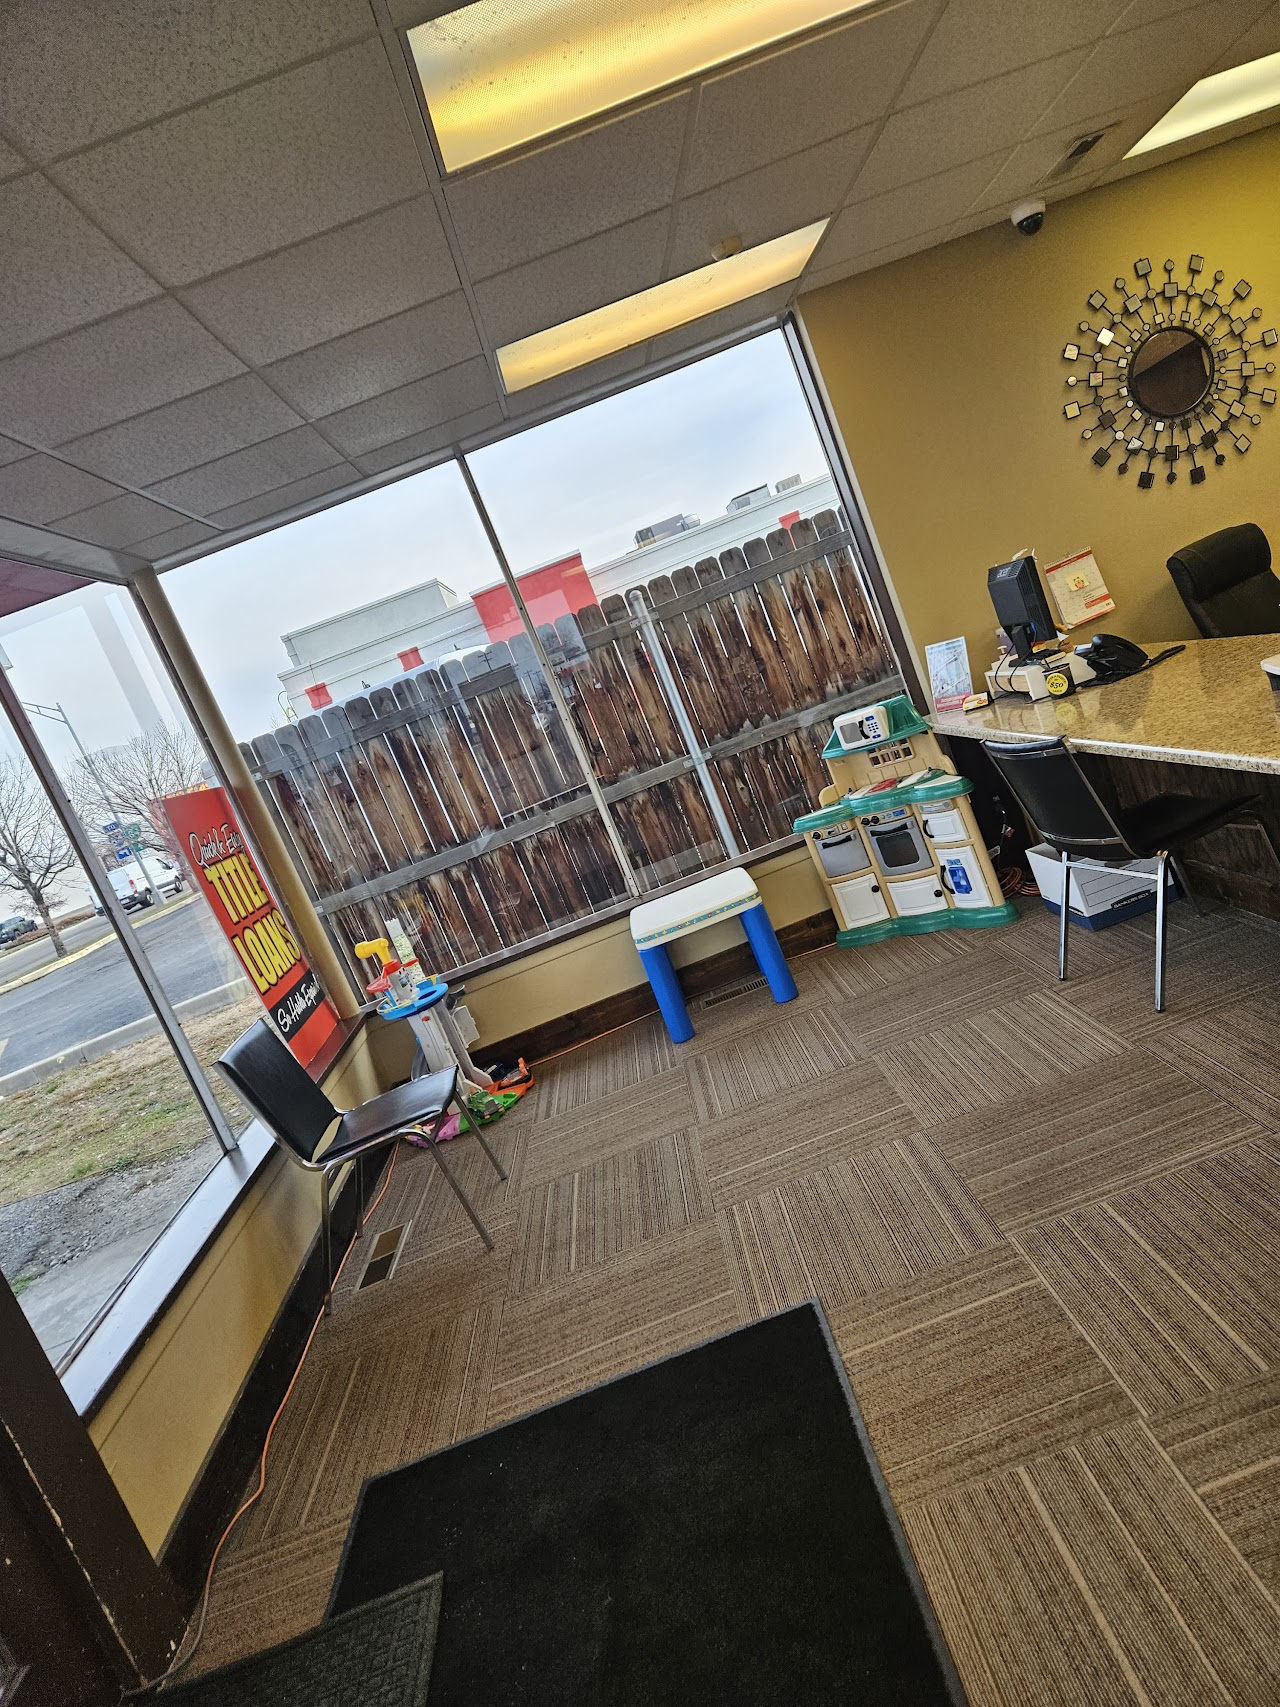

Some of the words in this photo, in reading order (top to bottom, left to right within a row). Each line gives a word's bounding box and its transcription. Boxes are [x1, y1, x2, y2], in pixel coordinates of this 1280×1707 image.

[189, 830, 222, 869] Quick
[203, 852, 270, 925] TITLE
[232, 908, 301, 995] LOANS
